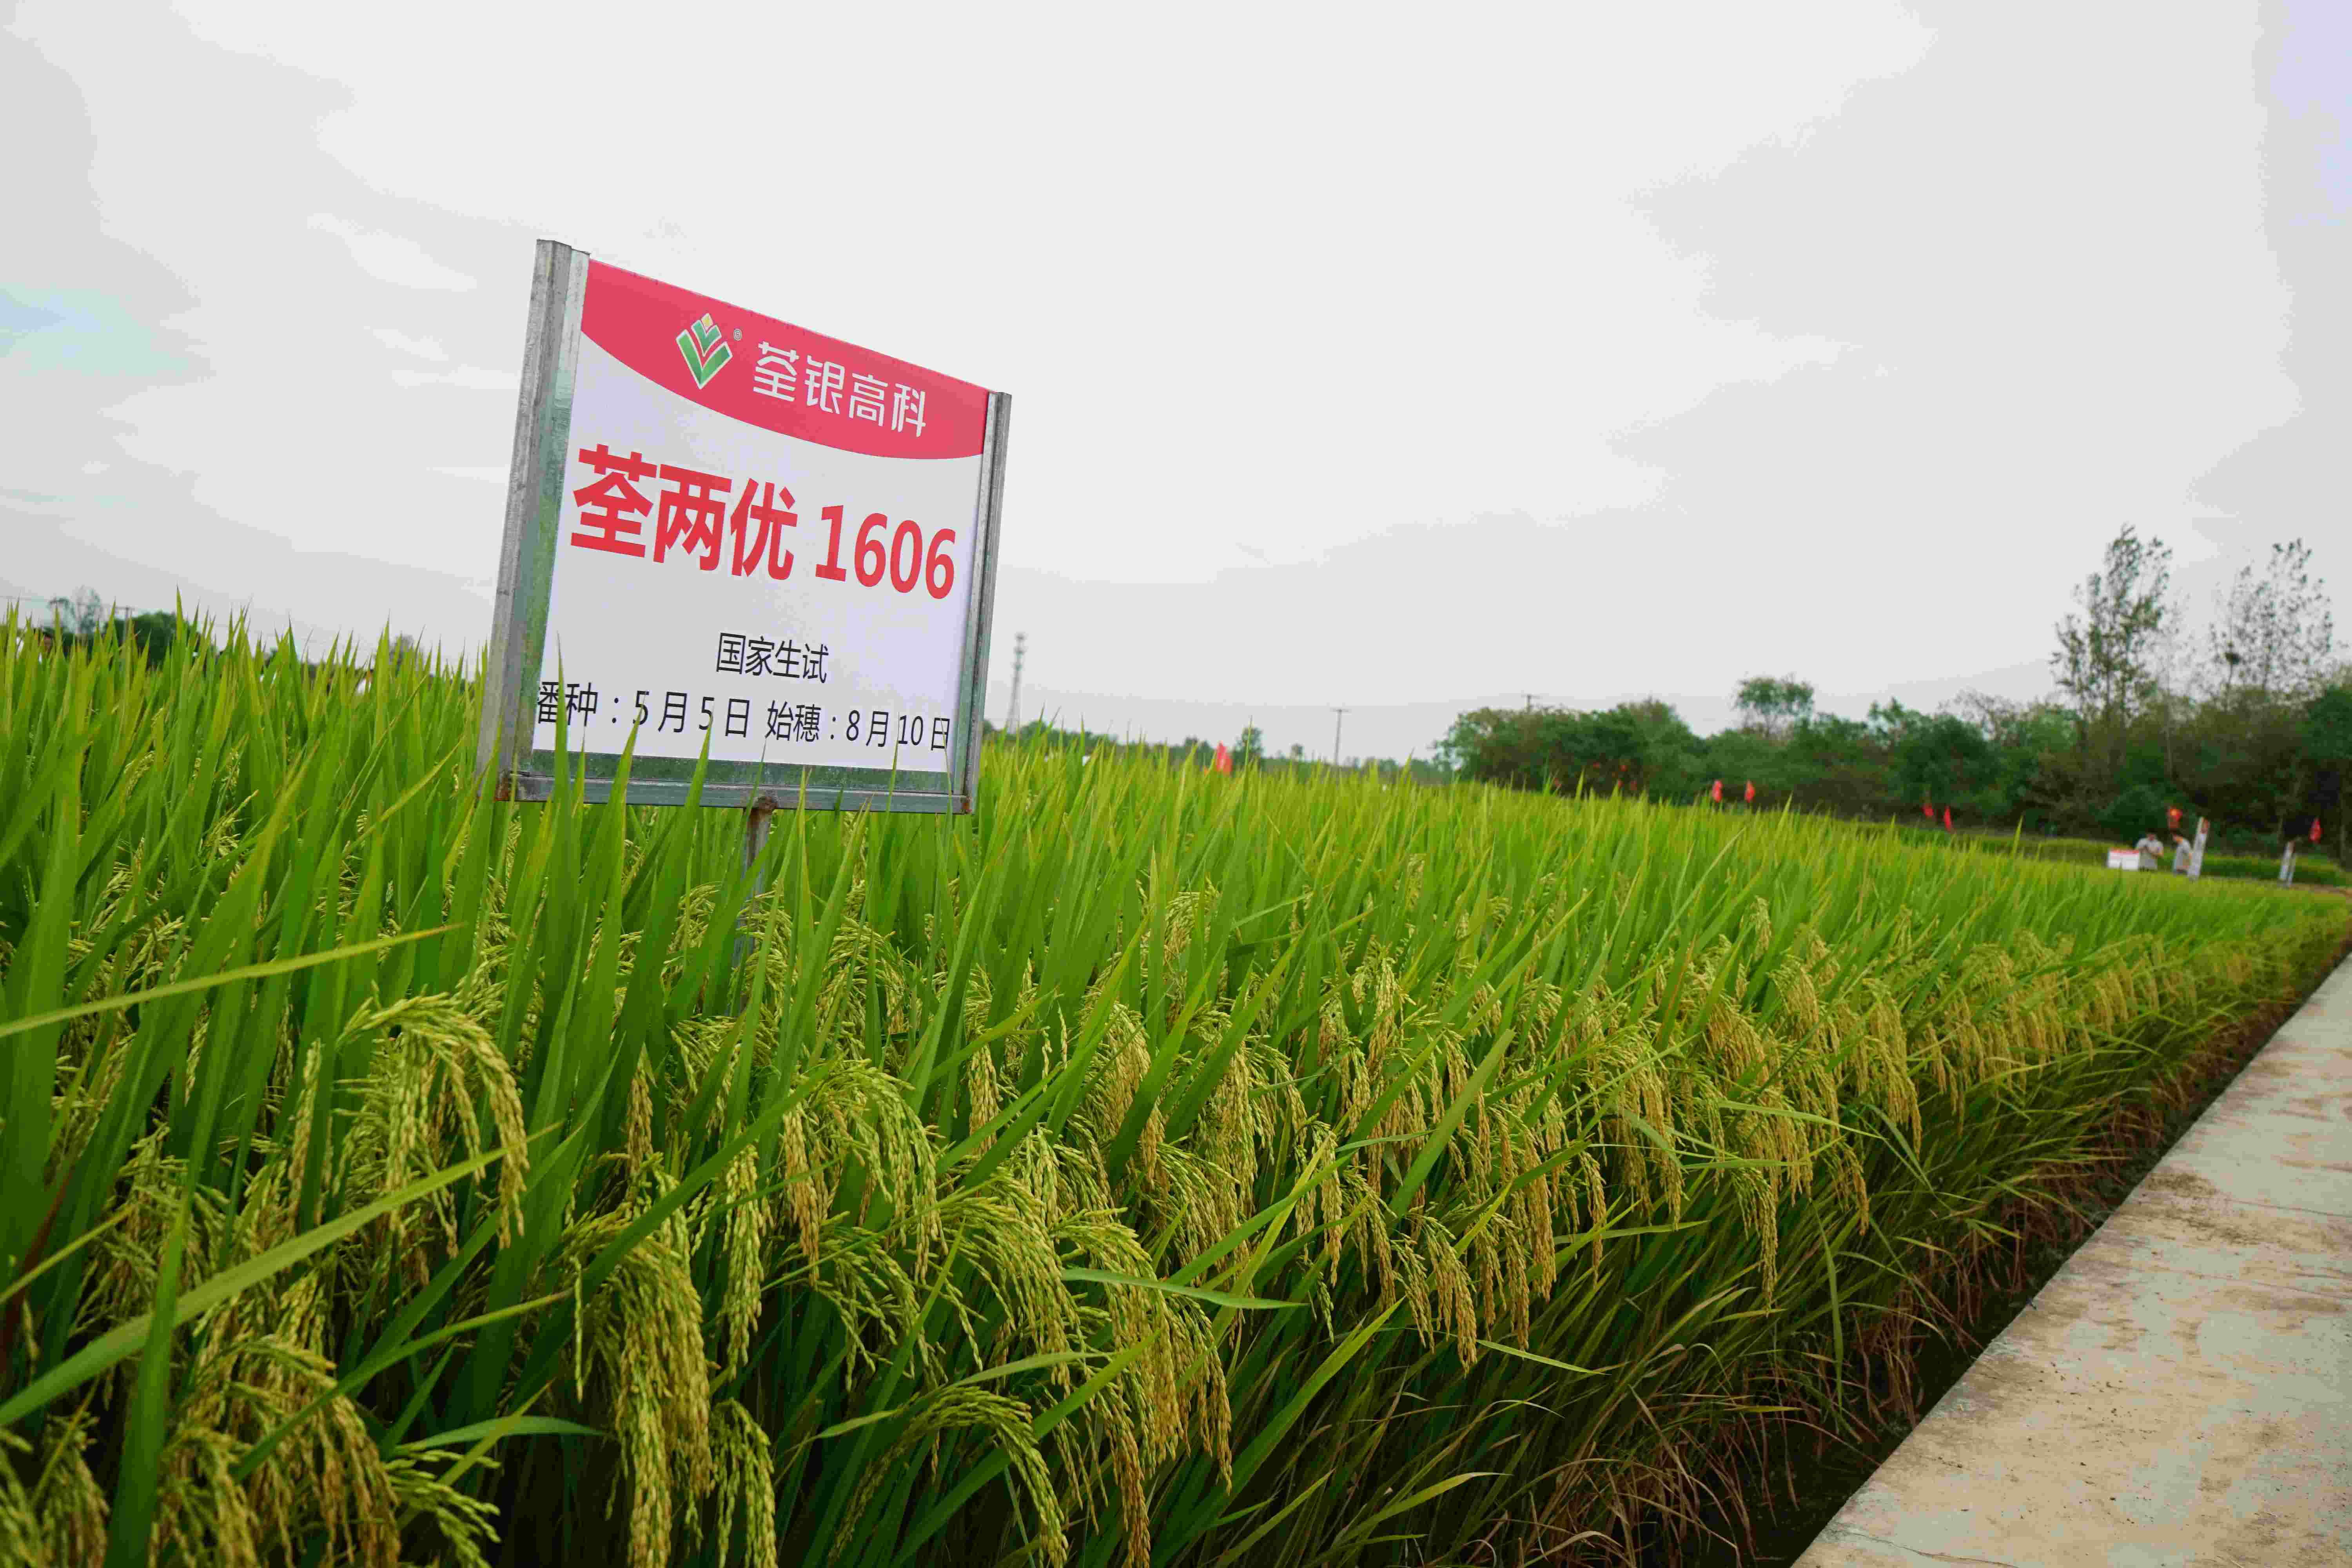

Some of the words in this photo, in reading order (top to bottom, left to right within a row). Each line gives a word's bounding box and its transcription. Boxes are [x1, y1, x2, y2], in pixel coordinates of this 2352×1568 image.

[753, 341, 927, 437] 荃银高科
[570, 444, 798, 580] 荃两优
[815, 505, 956, 600] 1606
[716, 633, 829, 684] 国家生试
